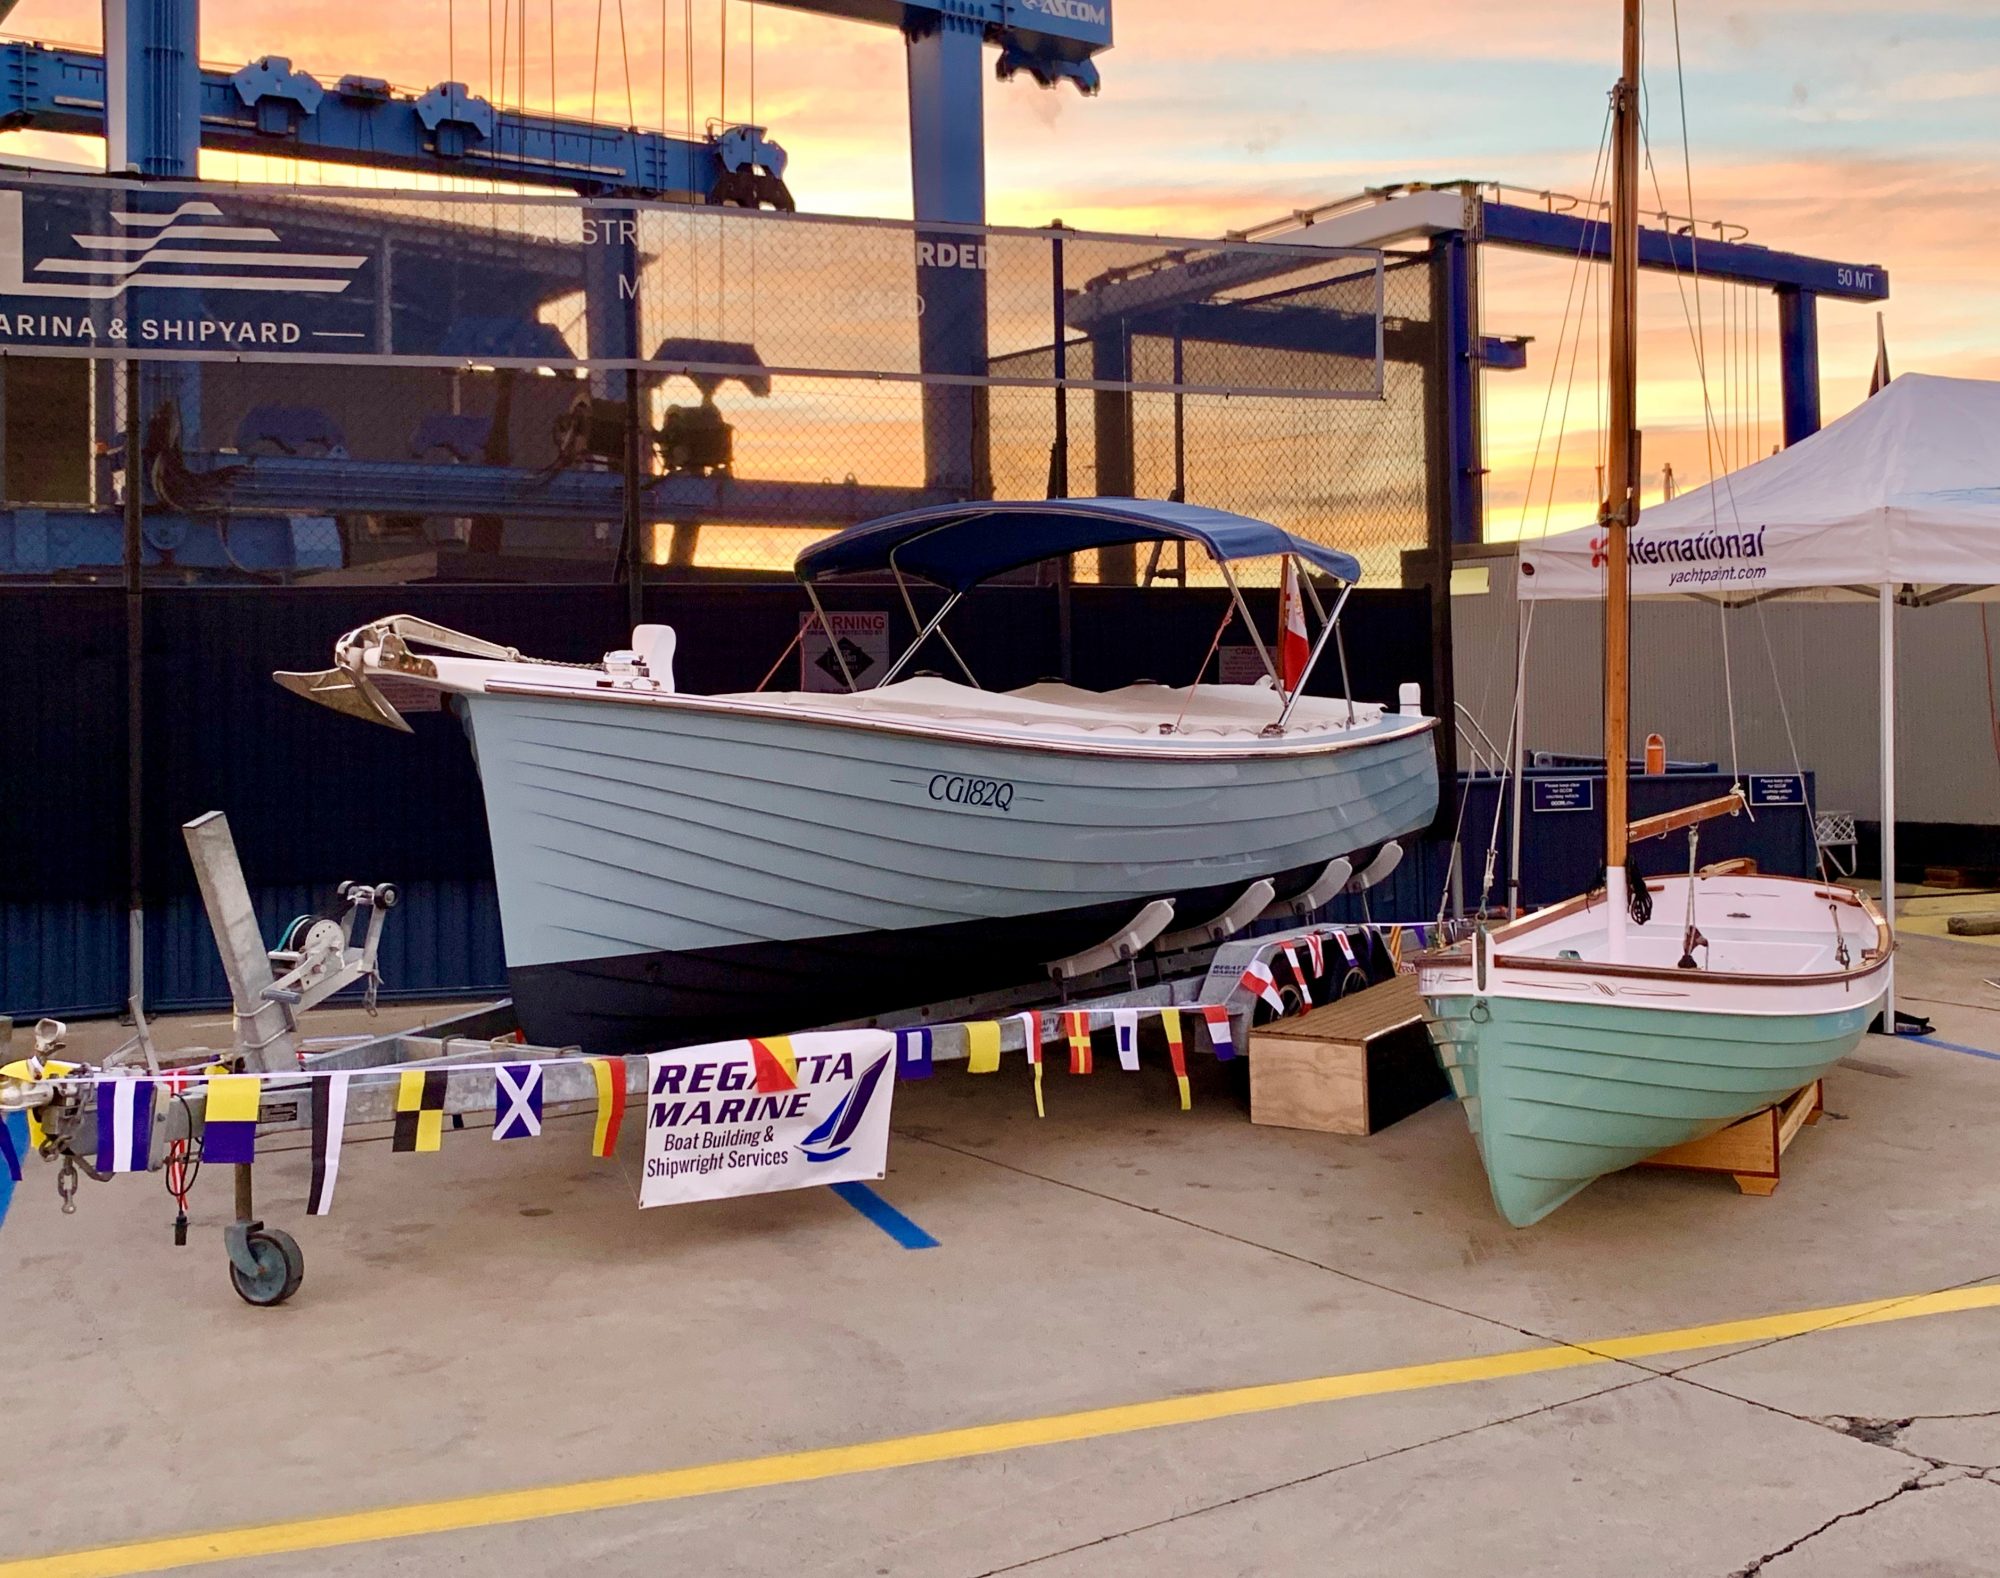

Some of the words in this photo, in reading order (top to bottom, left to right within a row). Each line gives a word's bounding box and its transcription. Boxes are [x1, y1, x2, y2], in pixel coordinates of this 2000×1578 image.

[1837, 268, 1853, 287] 50
[1855, 271, 1875, 290] MT
[108, 318, 128, 340] &
[141, 318, 302, 344] SHIPYARD
[1626, 525, 1766, 566] nternational
[1668, 566, 1767, 587] yachtpaint.com
[928, 774, 1014, 812] CG182Q
[652, 1052, 853, 1095] REGTTA
[649, 1093, 811, 1128] MARINE
[664, 1132, 699, 1151] Boat
[702, 1128, 760, 1149] Building
[763, 1125, 774, 1142] &
[647, 1152, 725, 1179] Shipwright
[727, 1149, 788, 1169] Services
